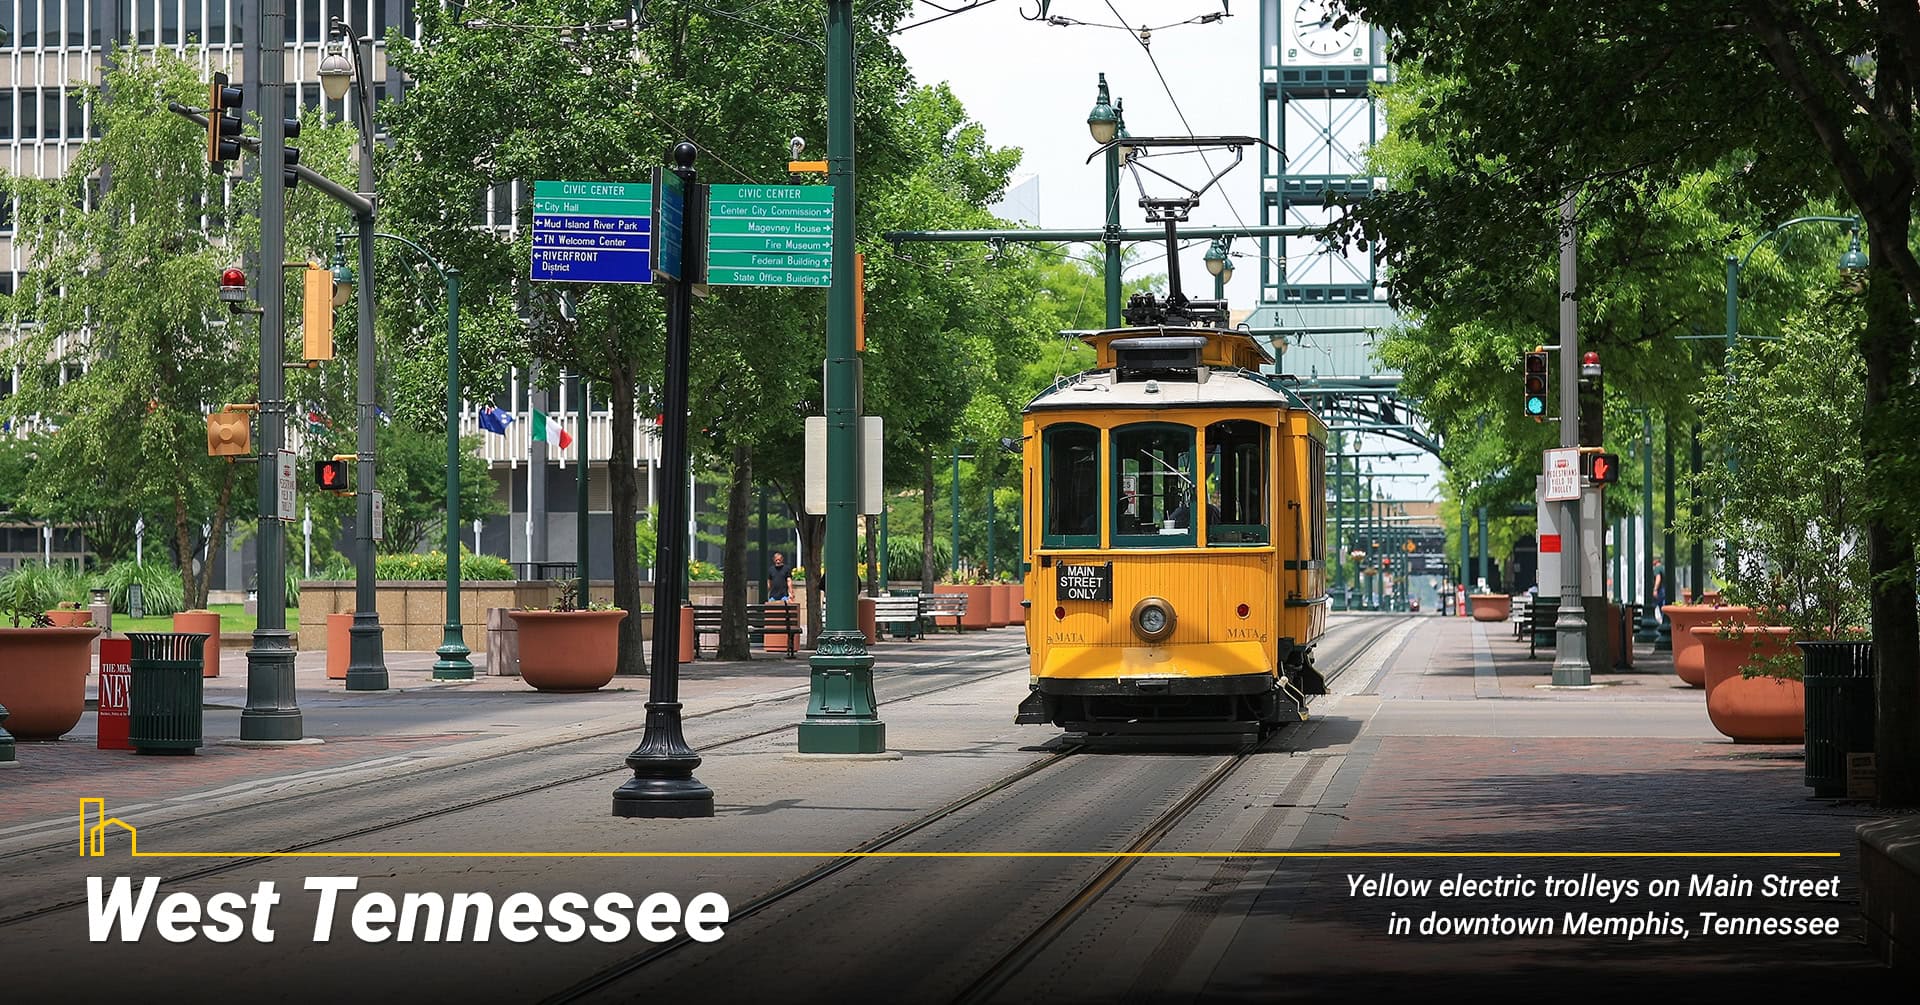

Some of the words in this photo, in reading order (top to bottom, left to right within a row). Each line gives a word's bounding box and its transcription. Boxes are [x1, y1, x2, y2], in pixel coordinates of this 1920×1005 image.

[563, 185, 587, 195] CIVIC
[590, 185, 625, 196] CENTER
[738, 188, 762, 198] CIVIC
[766, 189, 801, 199] CENTER
[544, 202, 560, 213] City
[563, 202, 579, 212] Hall
[720, 204, 748, 215] Center
[752, 205, 767, 216] City
[771, 206, 822, 216] Commission
[544, 218, 561, 228] Mud
[565, 219, 590, 229] Island
[594, 220, 615, 230] River
[618, 220, 638, 230] Park
[748, 222, 791, 234] Magevney
[794, 223, 821, 233] House
[544, 234, 555, 244] TN
[559, 235, 595, 246] Welcome
[599, 236, 627, 246] Center
[765, 240, 782, 249] Fire
[786, 240, 821, 250] Museum
[542, 251, 598, 262] RIVERFRONT
[751, 255, 783, 265] Federal
[788, 256, 821, 267] Building
[542, 261, 570, 272] District
[733, 272, 755, 281] State
[759, 272, 782, 282] Office
[786, 273, 820, 284] Building
[1067, 566, 1095, 577] MAIN
[1060, 577, 1104, 588] STREET
[1068, 588, 1098, 600] ONLY
[1055, 632, 1084, 642] MATA
[1227, 628, 1259, 639] MATA
[102, 664, 115, 673] THE
